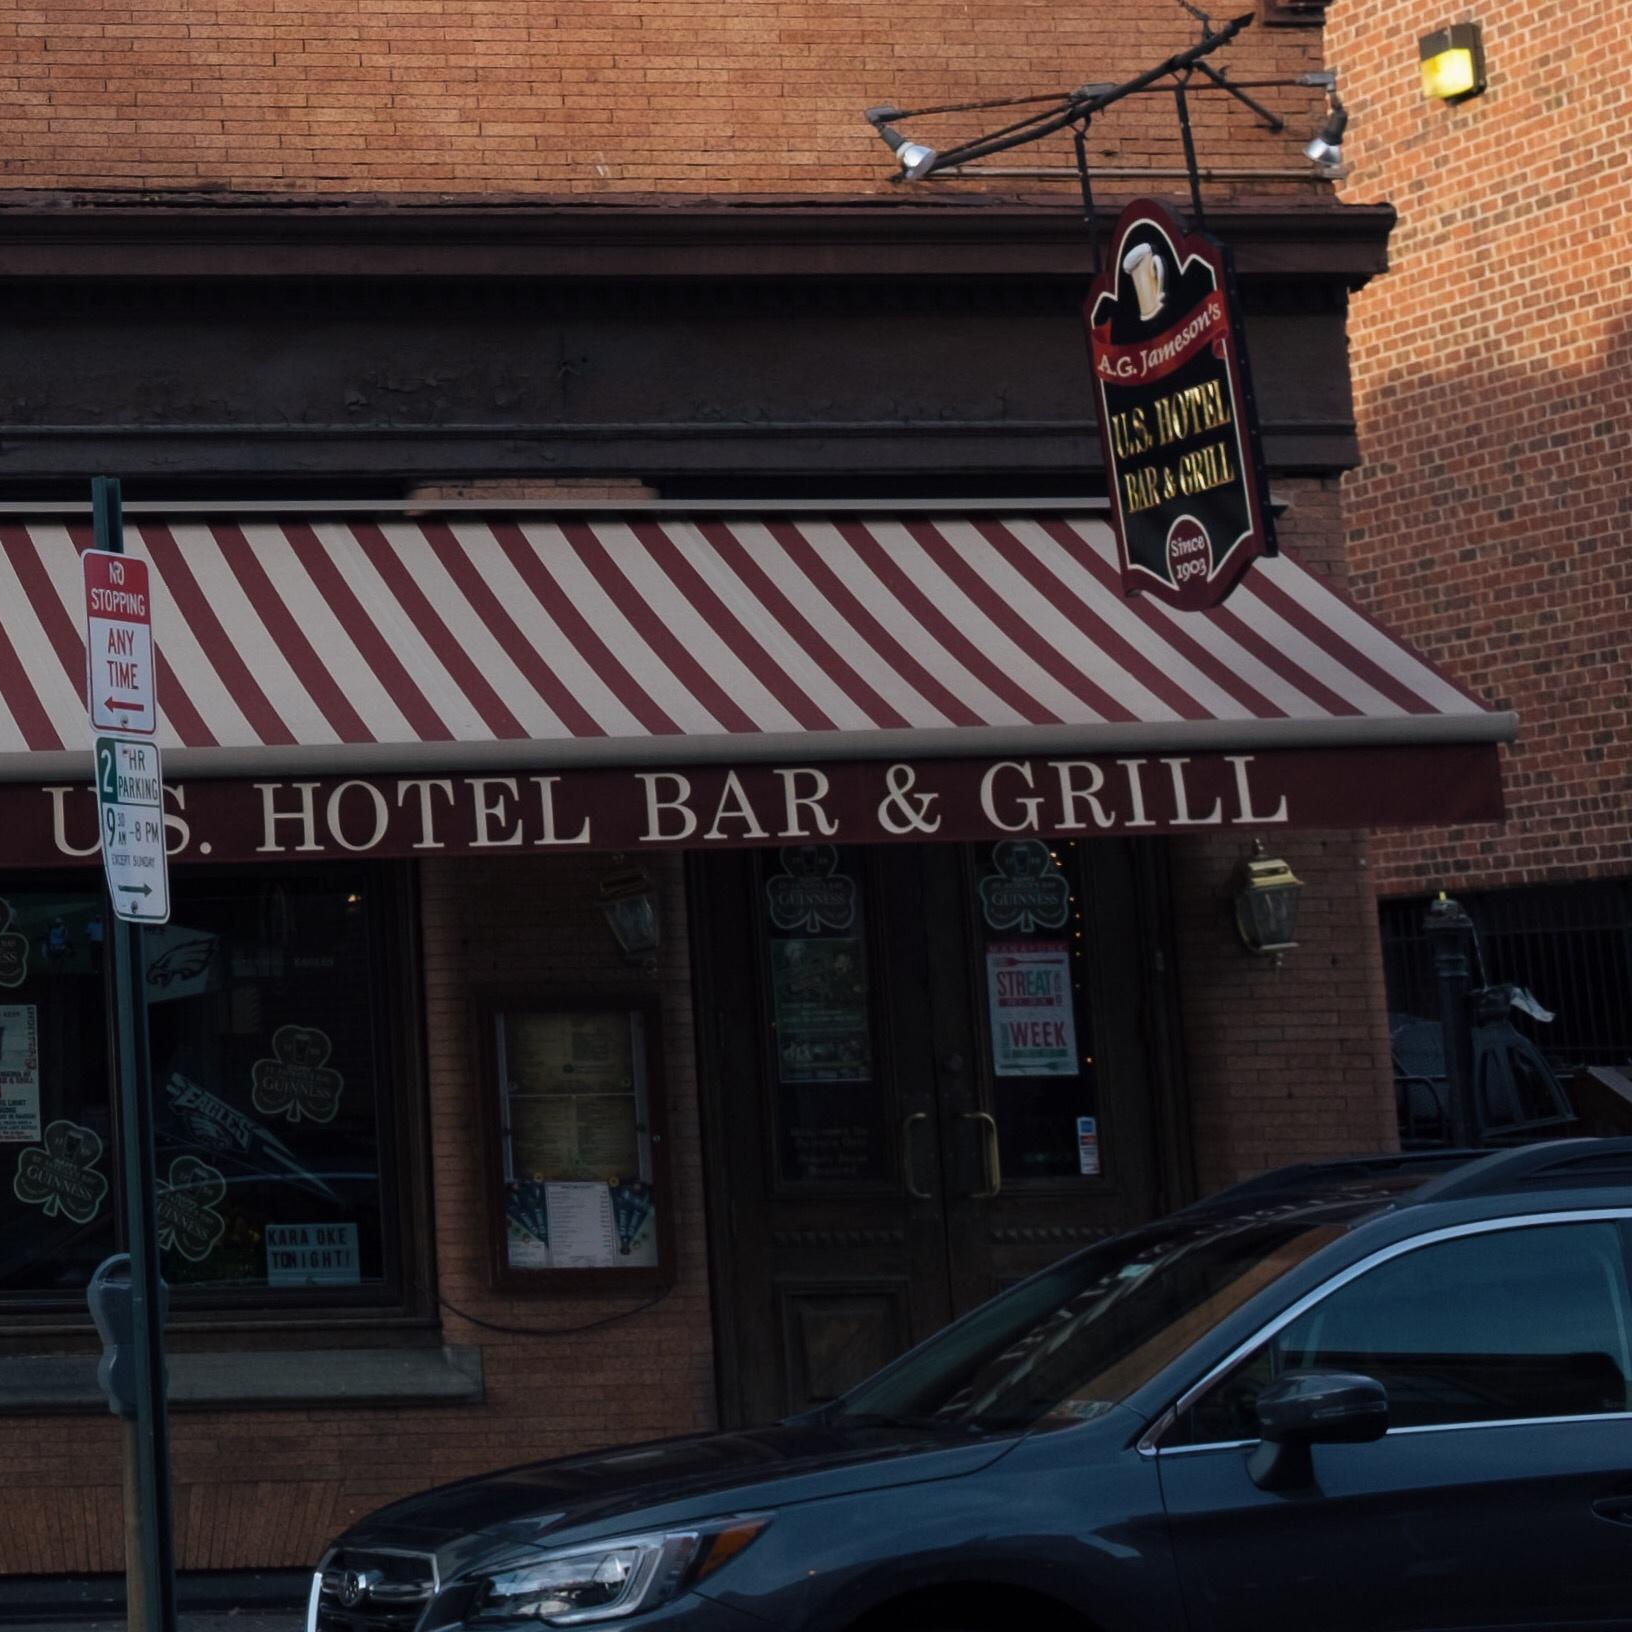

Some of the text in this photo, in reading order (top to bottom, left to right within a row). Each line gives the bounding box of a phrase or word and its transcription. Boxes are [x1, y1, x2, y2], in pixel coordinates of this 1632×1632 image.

[1098, 302, 1221, 378] A.G. Jameson's
[1112, 378, 1232, 459] U.S. HOTEL
[1124, 441, 1235, 514] BAR & GRILL
[1170, 535, 1205, 557] Since
[108, 560, 125, 585] NO
[1176, 558, 1207, 581] 1903
[90, 588, 146, 616] STOPPING
[107, 628, 135, 656] ANY
[107, 660, 139, 690] TIME
[100, 749, 146, 793] 2 HR
[118, 775, 158, 801] PARKING
[255, 776, 590, 852] HOTEL
[635, 768, 840, 841] BAR
[877, 764, 941, 835] &
[980, 751, 1288, 832] GRILL
[106, 807, 116, 847] 9
[145, 821, 159, 843] PM
[111, 853, 155, 868] EXCEPT SUNDAY
[991, 893, 1058, 906] GUINNESS
[996, 970, 1053, 997] STREAT
[1009, 1021, 1067, 1048] WEEK
[176, 1086, 255, 1151] EAGLES
[26, 1165, 94, 1200] GUINNESS
